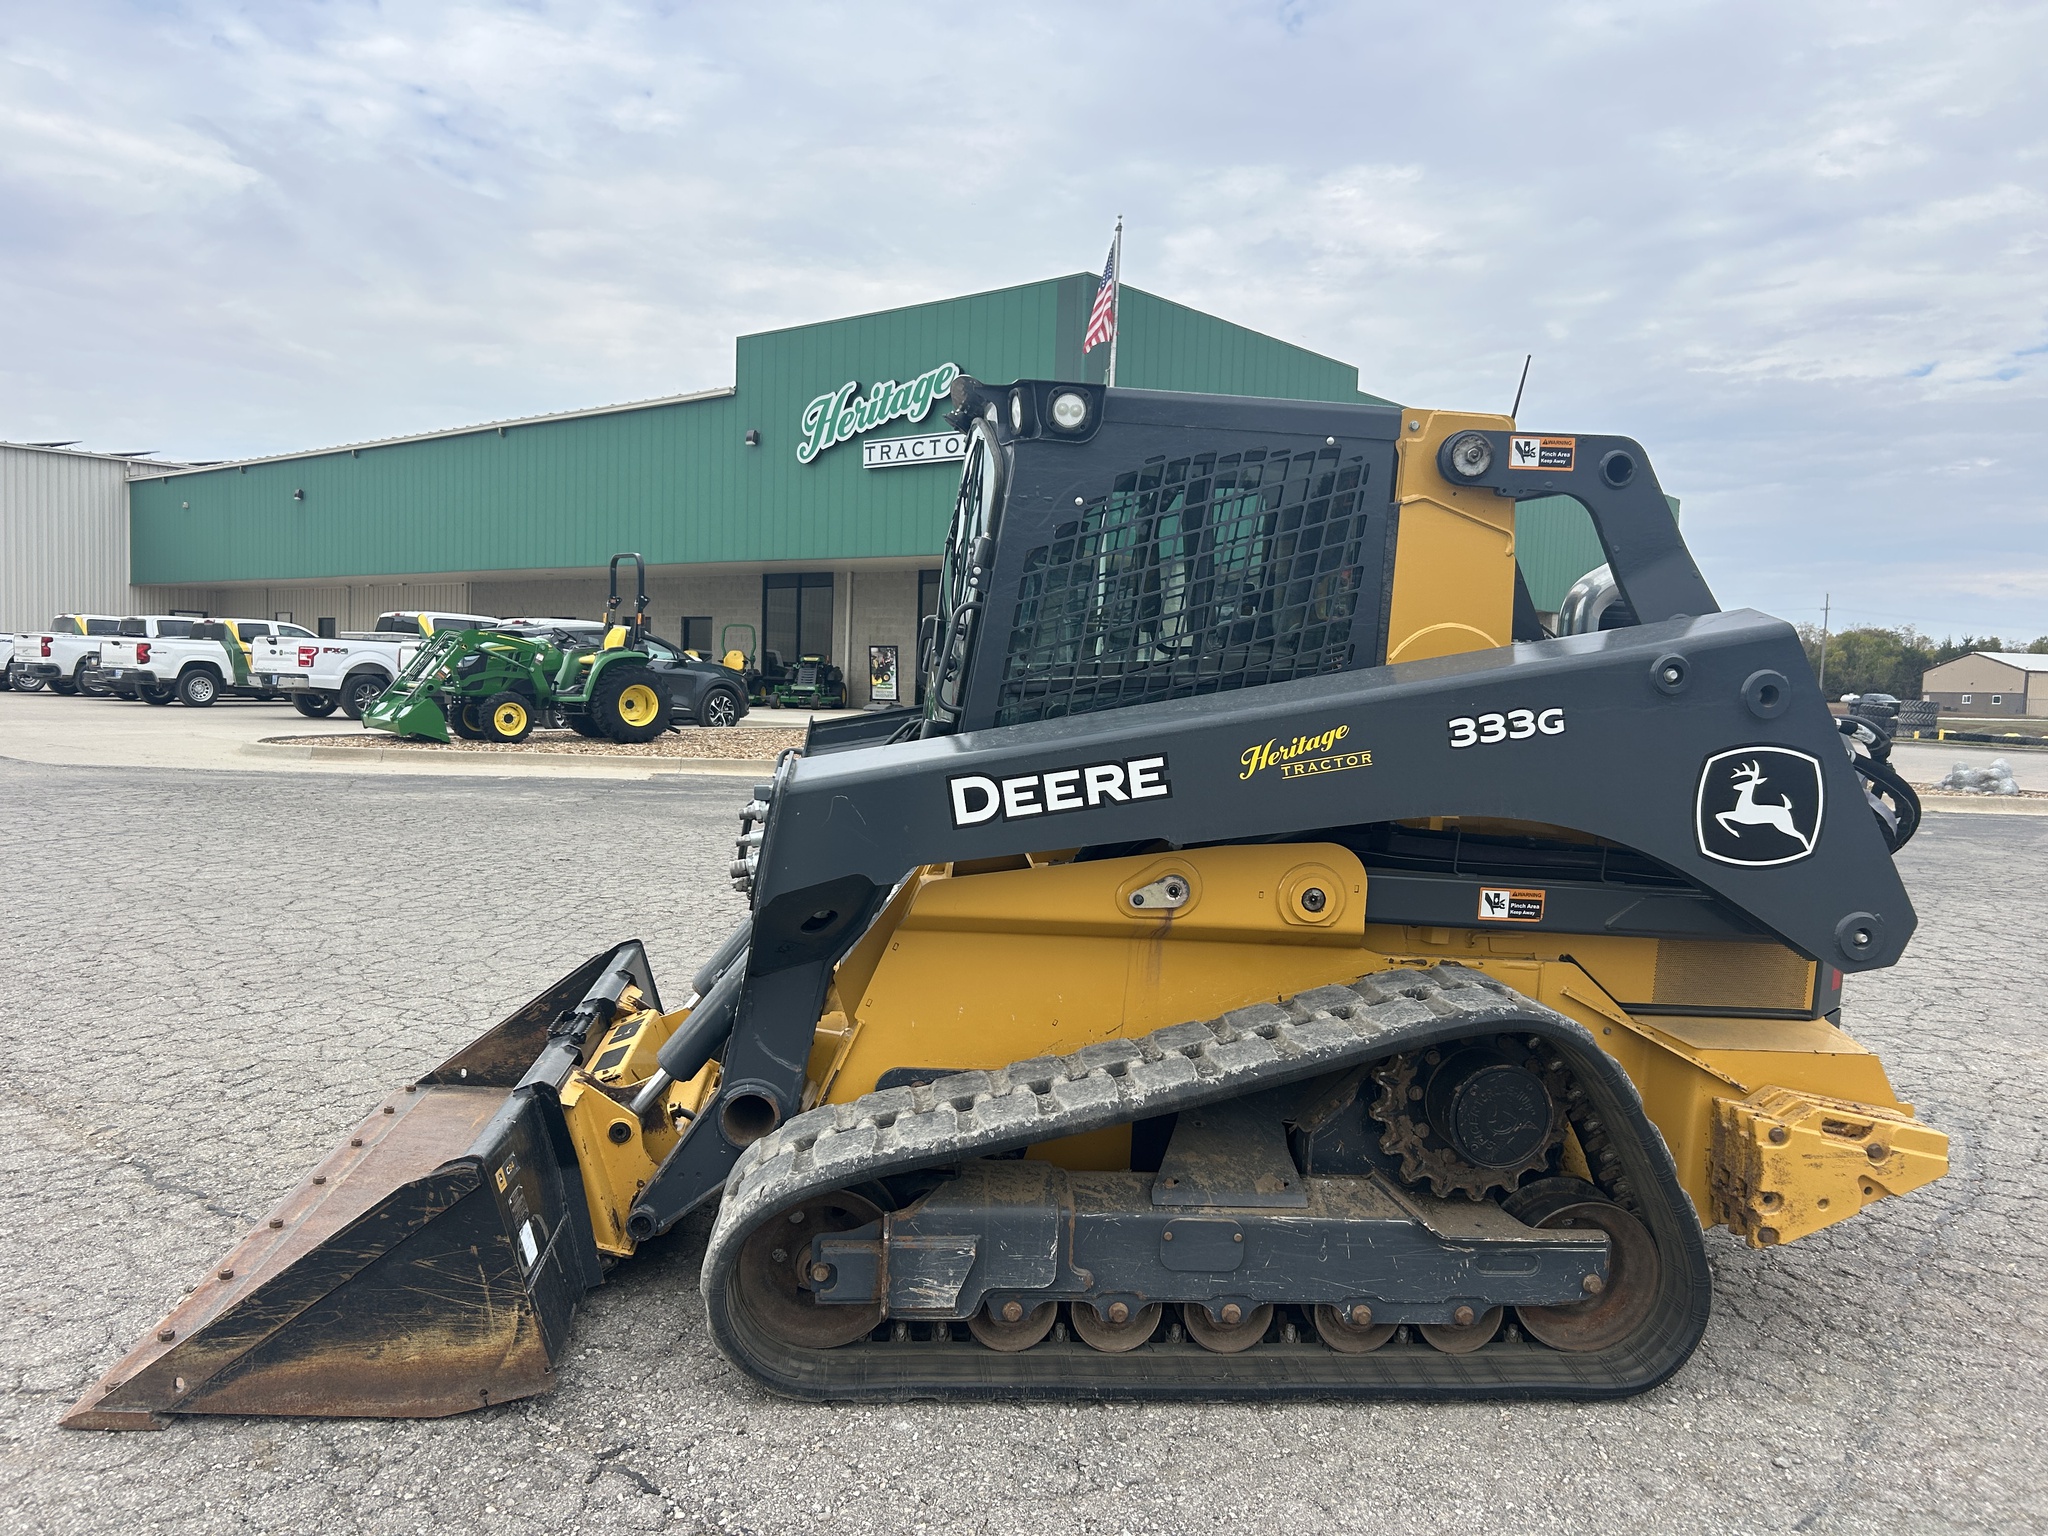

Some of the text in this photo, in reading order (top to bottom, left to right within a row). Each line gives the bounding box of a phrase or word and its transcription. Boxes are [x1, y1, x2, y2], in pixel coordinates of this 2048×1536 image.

[798, 363, 959, 463] Heritage
[865, 437, 960, 462] TRACTO
[1239, 724, 1350, 780] Heritage
[1449, 708, 1565, 748] 333G
[1282, 753, 1373, 777] TRACTOR
[950, 756, 1168, 826] DEERE
